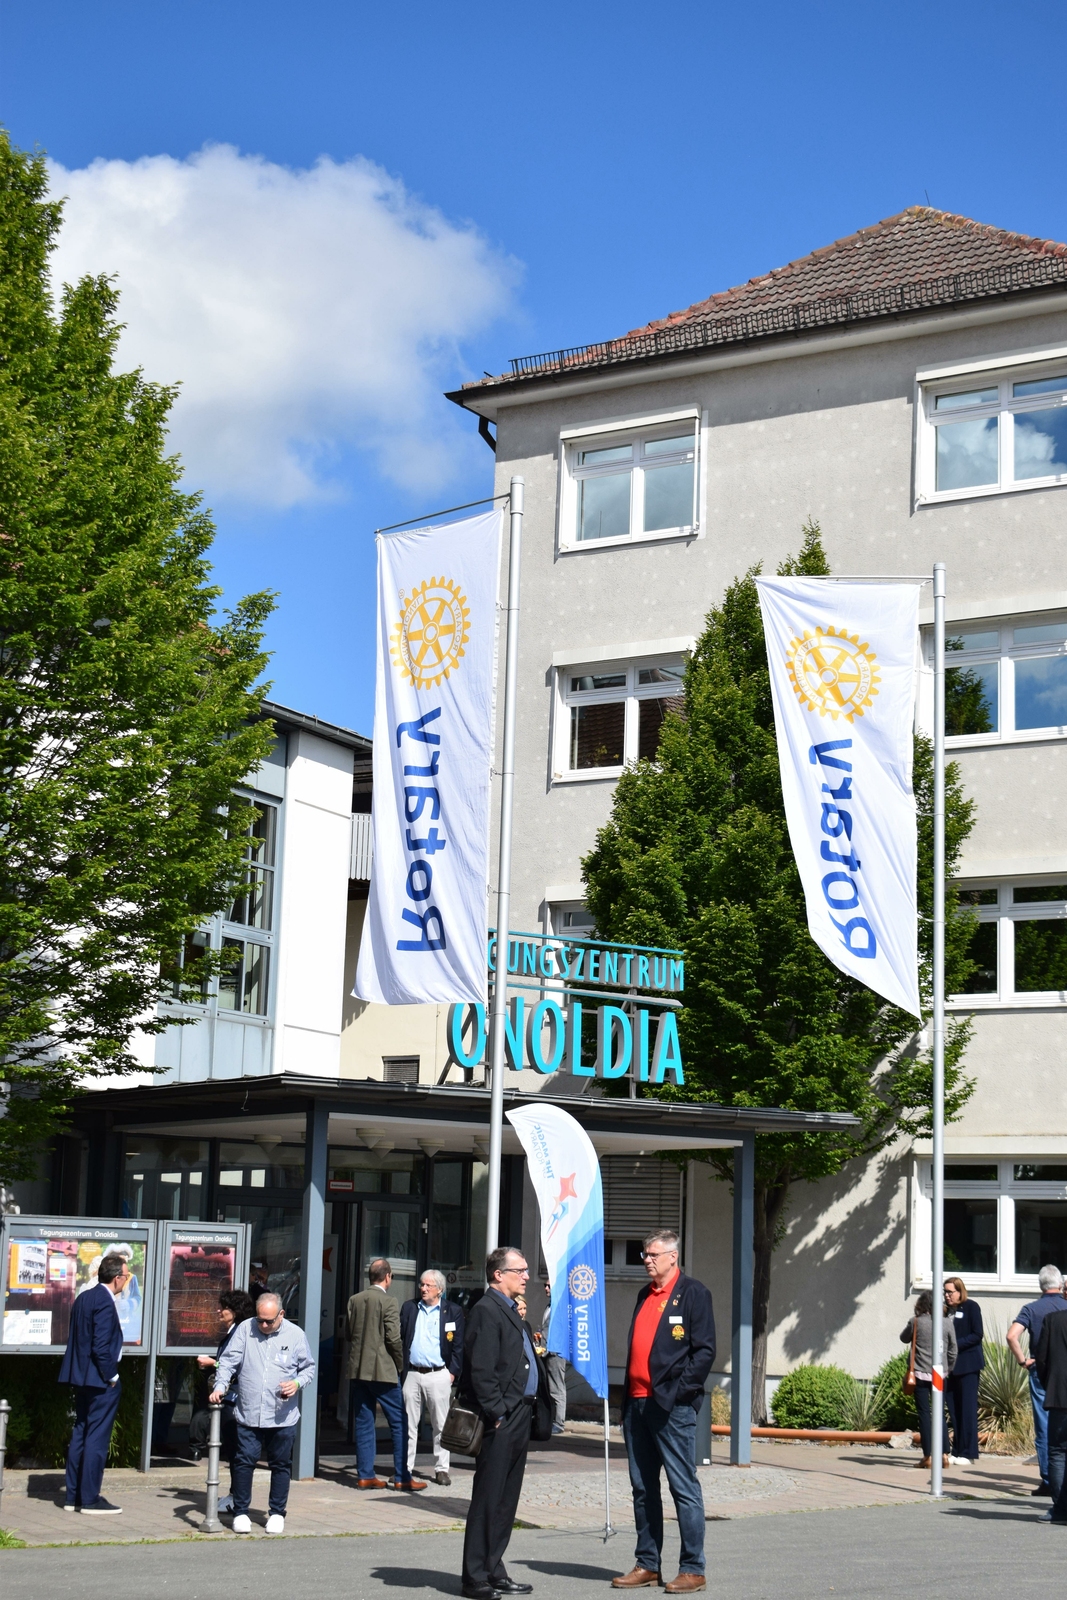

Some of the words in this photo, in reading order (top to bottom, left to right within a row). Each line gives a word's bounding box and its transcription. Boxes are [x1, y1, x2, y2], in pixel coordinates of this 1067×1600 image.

[449, 996, 685, 1086] ONOLDIA
[39, 1228, 92, 1238] Tagungszentrum
[94, 1230, 119, 1239] Onoldia
[175, 1233, 214, 1243] Tagungszentrum
[214, 1235, 233, 1243] Onoldia
